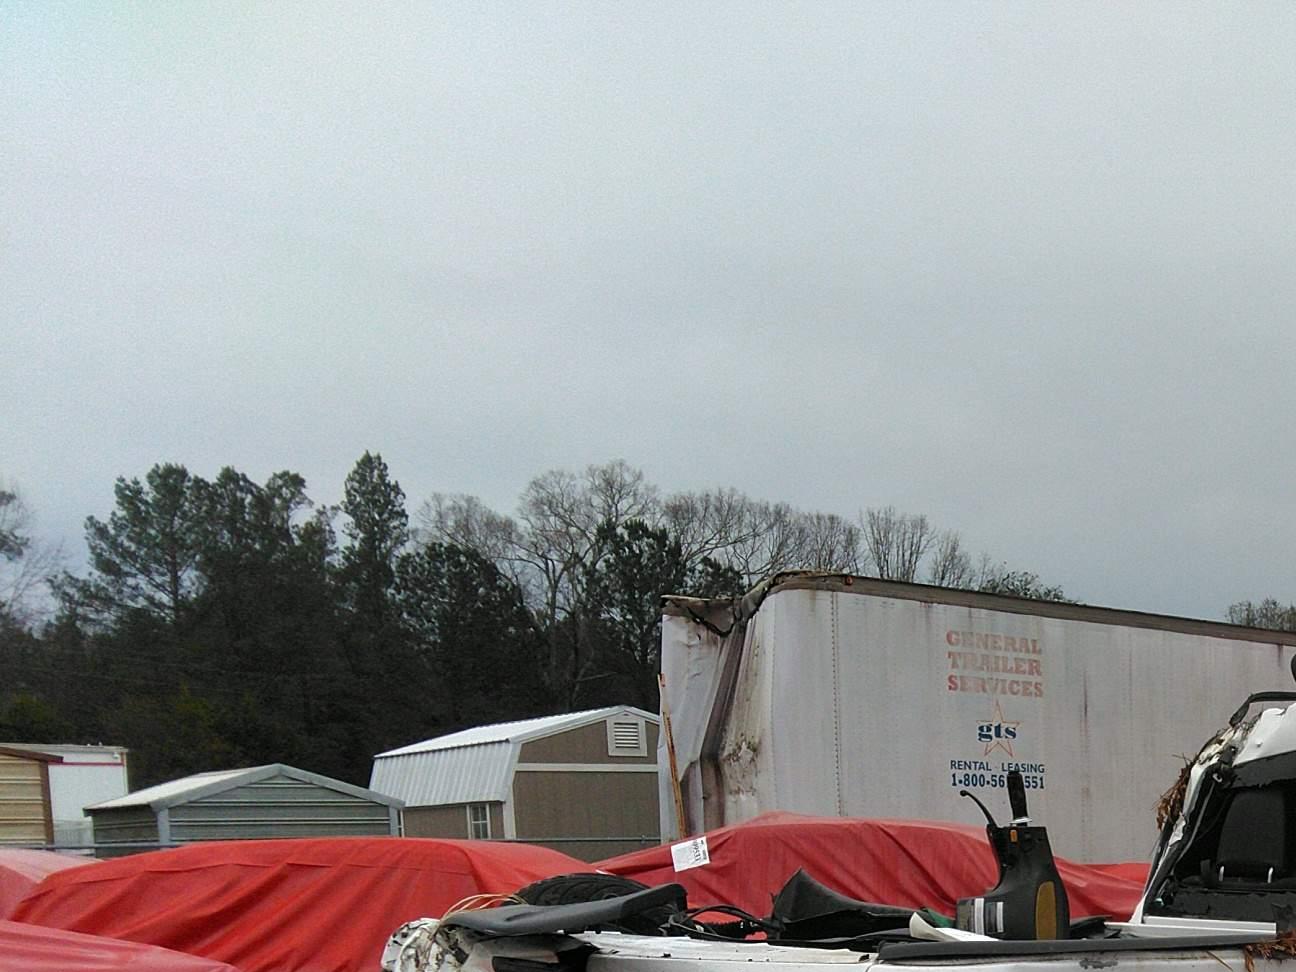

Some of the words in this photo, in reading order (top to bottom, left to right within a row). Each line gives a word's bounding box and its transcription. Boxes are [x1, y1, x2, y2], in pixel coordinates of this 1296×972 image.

[946, 630, 1042, 655] GENERAL
[946, 651, 1042, 676] TRAILER
[947, 674, 1044, 698] SERVICES
[978, 723, 1017, 743] gts
[950, 760, 992, 772] RENTAL
[1001, 762, 1045, 774] LEASING
